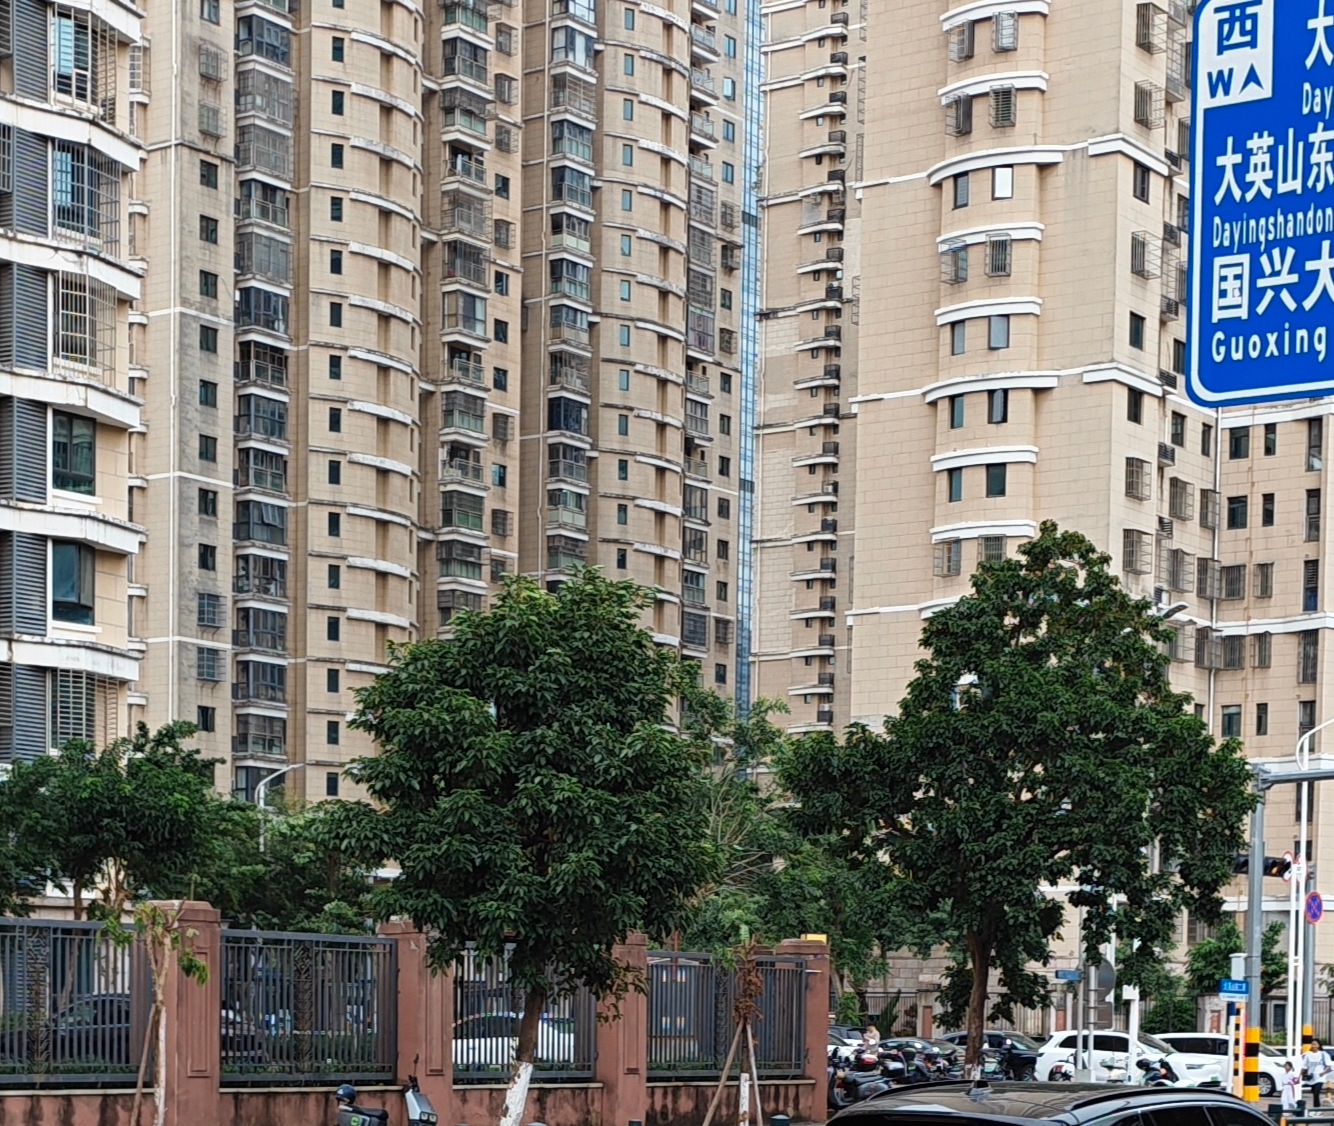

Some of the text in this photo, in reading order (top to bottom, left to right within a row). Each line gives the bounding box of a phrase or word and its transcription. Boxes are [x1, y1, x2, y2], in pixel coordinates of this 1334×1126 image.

[1213, 1, 1263, 56] 西
[1207, 67, 1234, 99] W
[1211, 322, 1327, 363] Guoxing
